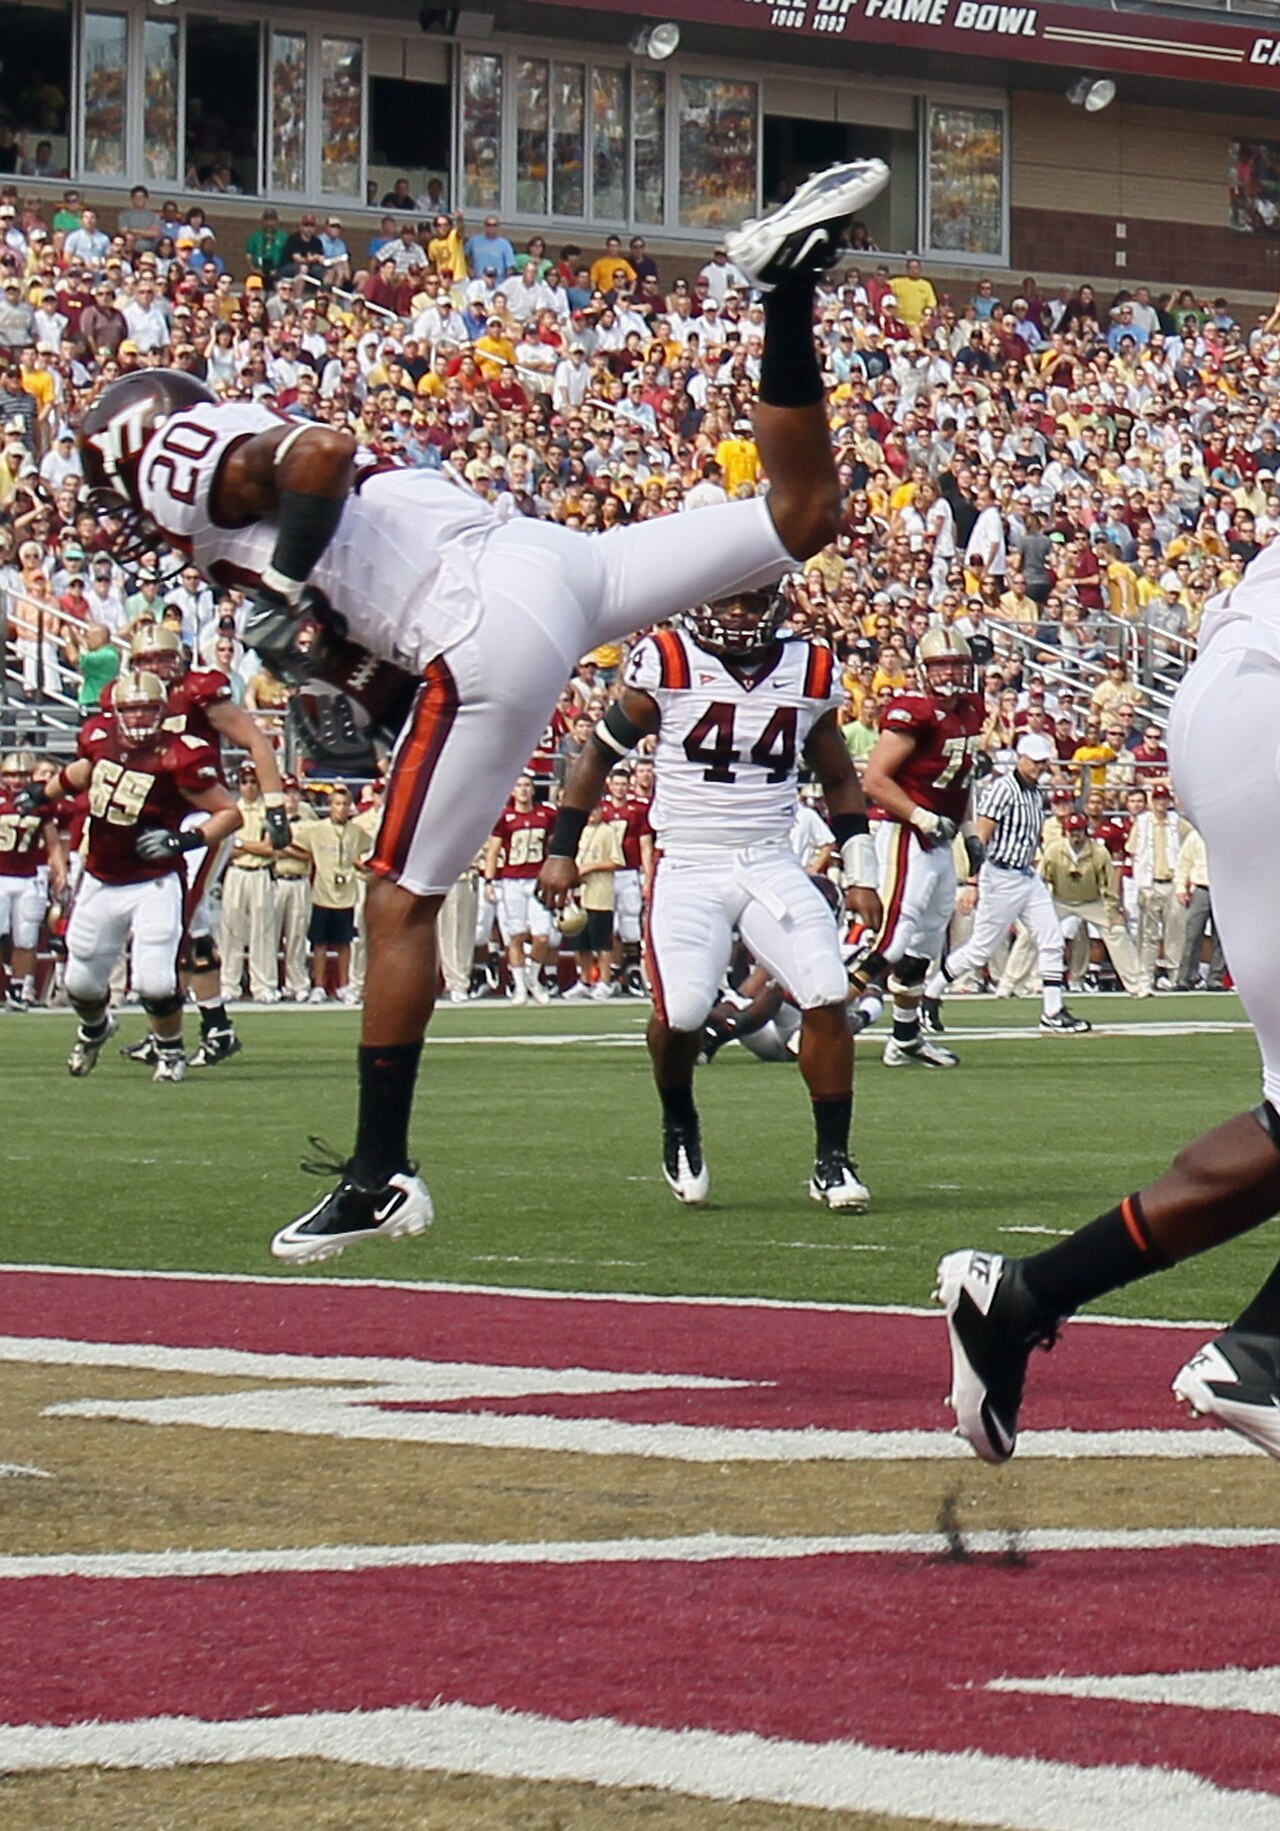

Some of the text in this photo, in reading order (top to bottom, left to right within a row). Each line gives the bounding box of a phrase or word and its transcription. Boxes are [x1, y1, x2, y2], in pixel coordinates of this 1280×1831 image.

[865, 0, 946, 25] FAME
[953, 1, 1037, 36] BOWL
[147, 421, 219, 506] 20
[683, 701, 798, 784] 44
[88, 758, 156, 826] 69
[0, 813, 42, 853] 57
